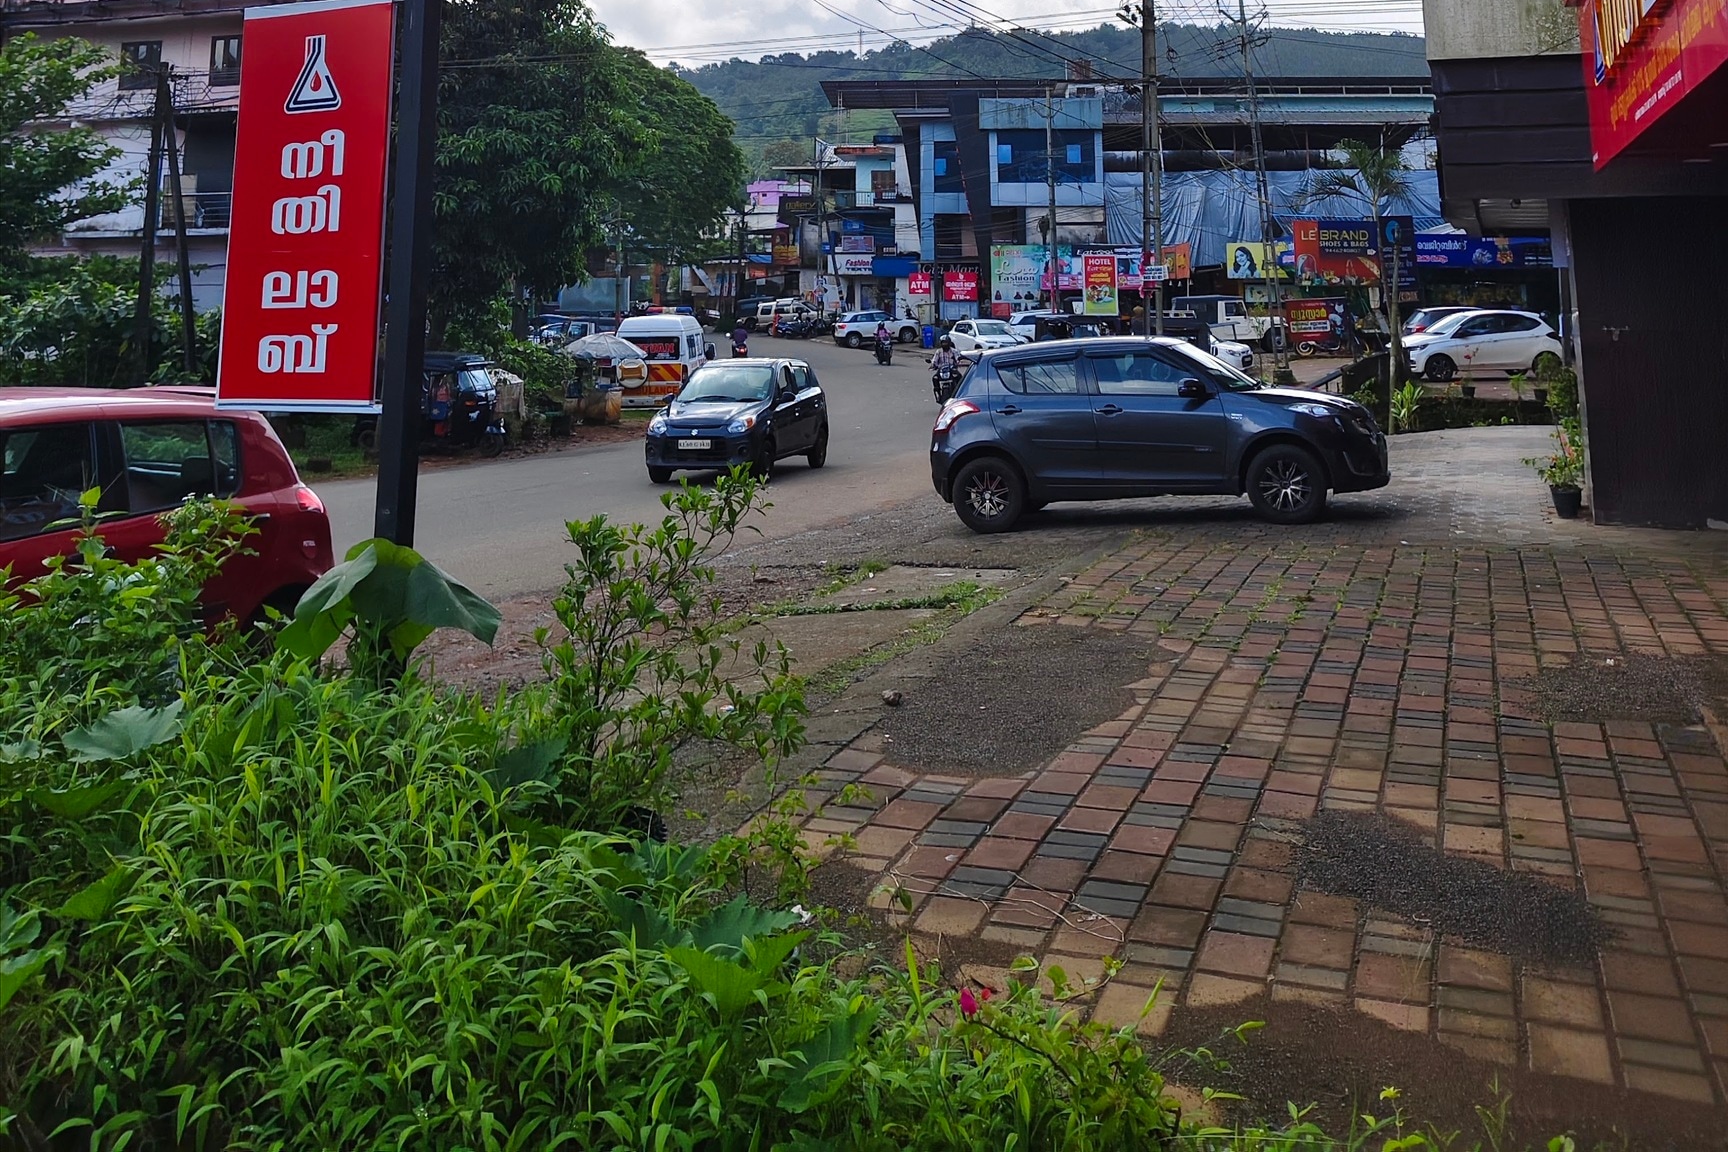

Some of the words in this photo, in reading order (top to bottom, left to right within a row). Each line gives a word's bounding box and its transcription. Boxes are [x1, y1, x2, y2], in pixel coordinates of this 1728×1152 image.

[1319, 229, 1369, 241] BRAND
[1319, 240, 1341, 248] SHOES
[1350, 240, 1370, 248] BAGS
[1088, 258, 1112, 266] HOTEL
[998, 274, 1035, 282] Fashion
[910, 281, 930, 289] ATM
